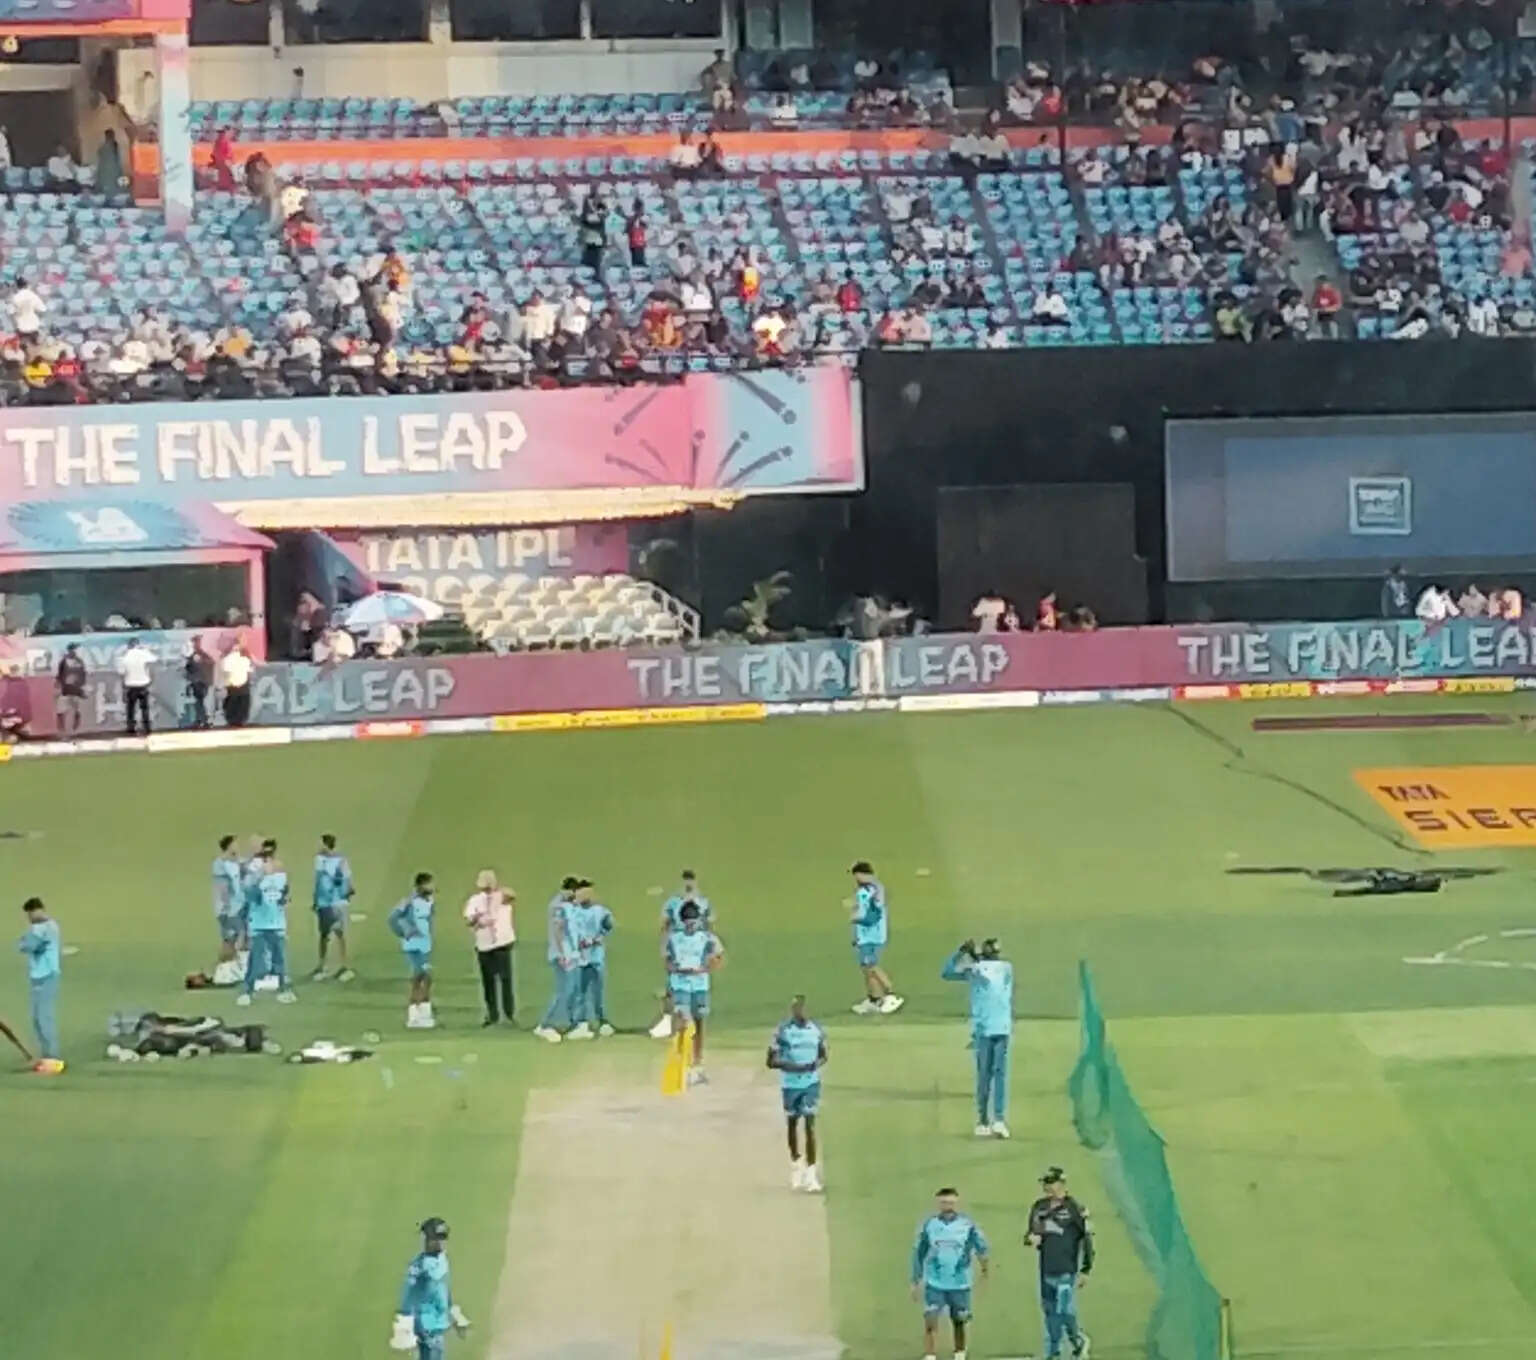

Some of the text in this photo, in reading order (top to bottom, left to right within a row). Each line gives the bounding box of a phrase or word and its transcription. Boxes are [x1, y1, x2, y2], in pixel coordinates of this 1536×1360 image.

[4, 410, 528, 486] THE FINAL LEAP
[496, 528, 573, 569] IPL
[627, 653, 721, 698] THE
[890, 643, 1009, 688] LEAP
[1177, 632, 1270, 677] THE
[1288, 627, 1422, 673] FINAL
[333, 667, 455, 714] LEAP
